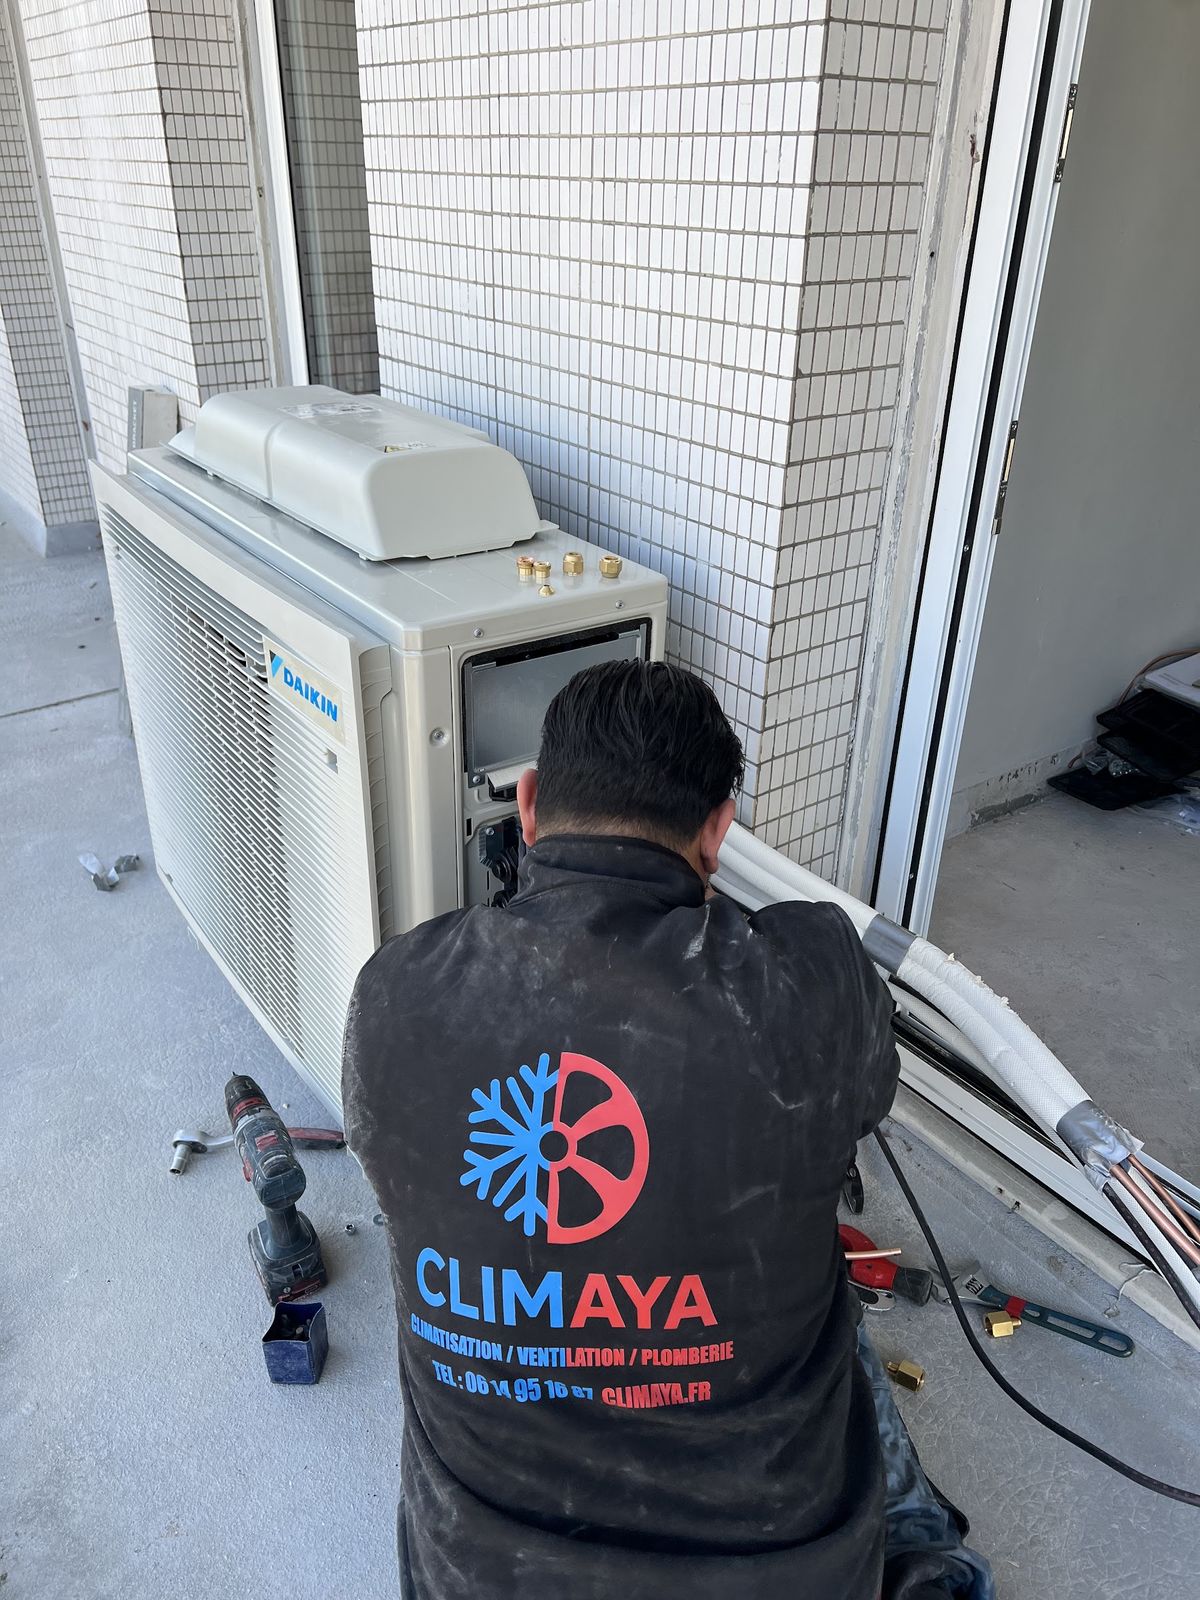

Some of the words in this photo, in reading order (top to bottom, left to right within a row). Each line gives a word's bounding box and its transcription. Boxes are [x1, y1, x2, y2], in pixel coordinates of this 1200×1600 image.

[283, 666, 338, 722] DAIKIN
[416, 1247, 719, 1330] CLIMAYA
[410, 1312, 503, 1362] CLIMATISATION
[517, 1346, 625, 1368] VENTILATION
[641, 1340, 734, 1367] PLOMBERIE
[464, 1371, 490, 1395] 06
[513, 1378, 542, 1403] 95
[544, 1379, 569, 1399] 16
[601, 1381, 711, 1409] CLIMAYA.FR
